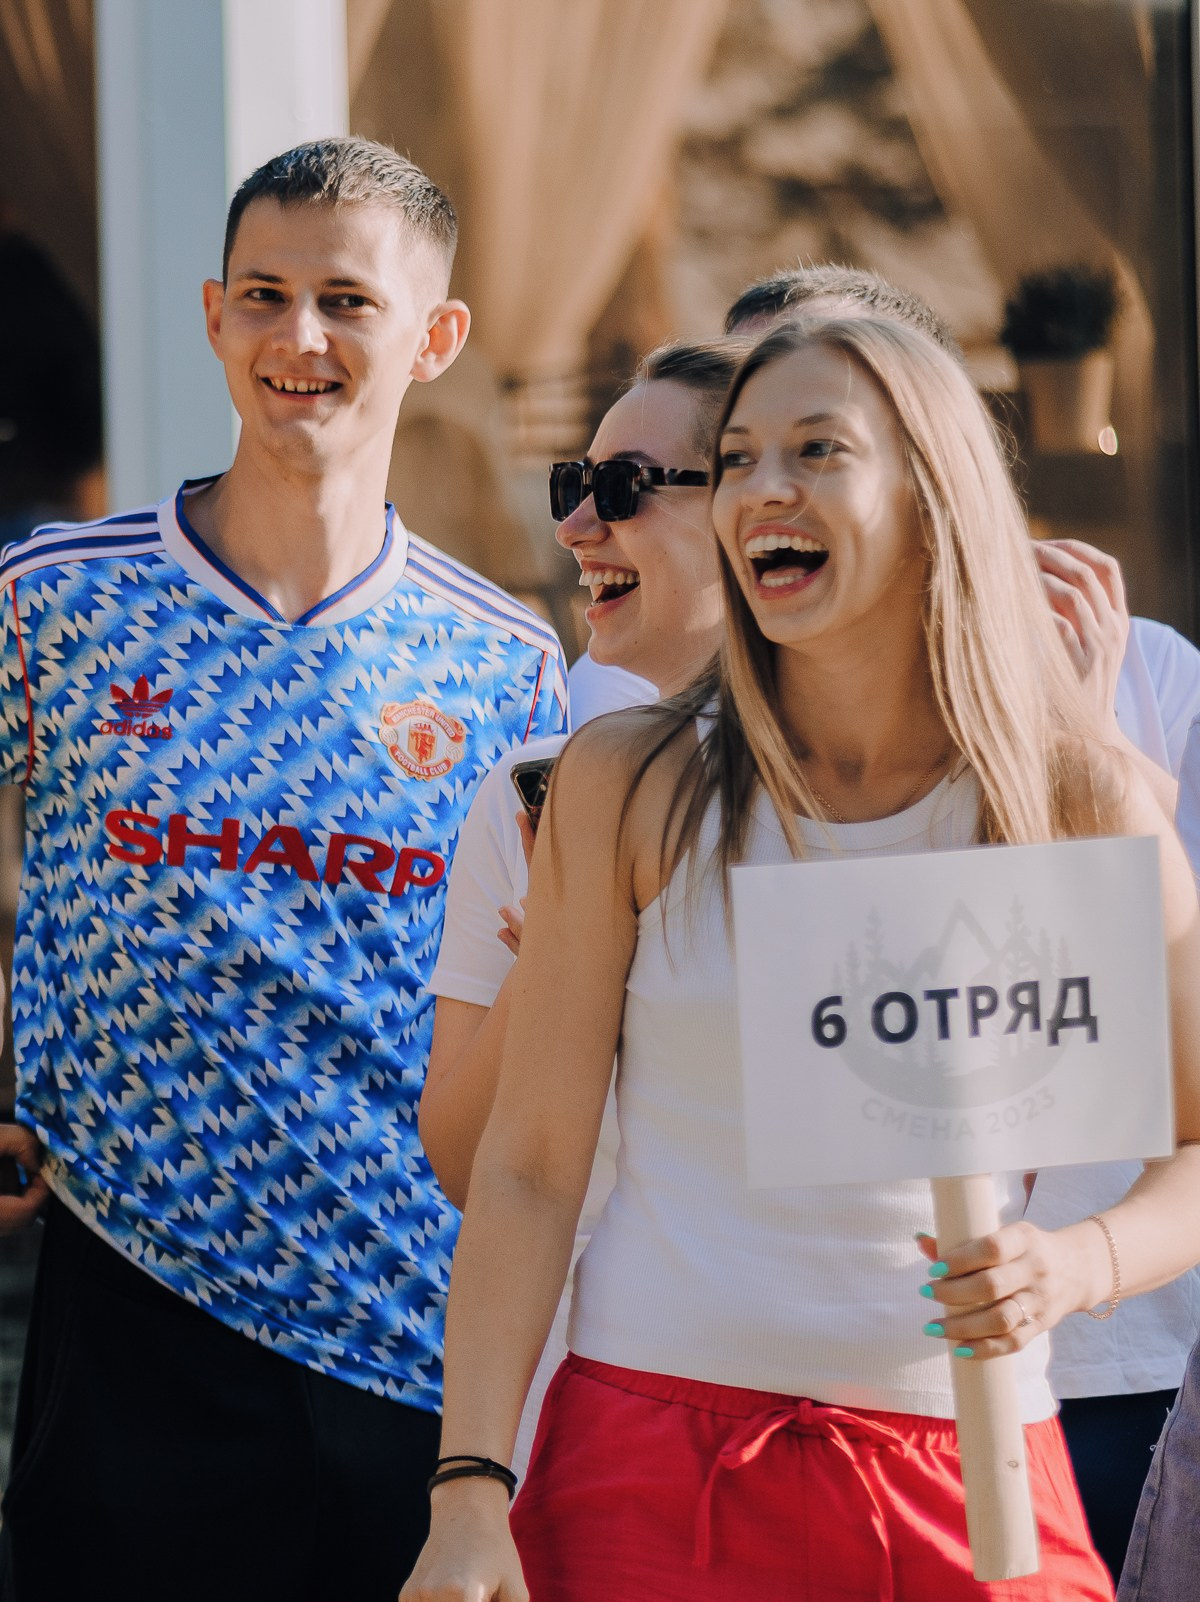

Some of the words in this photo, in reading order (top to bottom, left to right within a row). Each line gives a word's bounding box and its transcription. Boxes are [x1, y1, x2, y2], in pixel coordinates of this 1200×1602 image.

[100, 720, 173, 740] adidas
[391, 705, 435, 724] MANCHESTER
[435, 714, 456, 738] UNITED
[394, 750, 429, 776] FOOTBALL
[429, 763, 448, 776] CLUB
[105, 810, 446, 897] SHARP
[810, 995, 848, 1049] 6
[870, 975, 1100, 1048] ОТРЯД
[860, 1098, 977, 1142] СМЕНА
[985, 1086, 1057, 1135] 2023
